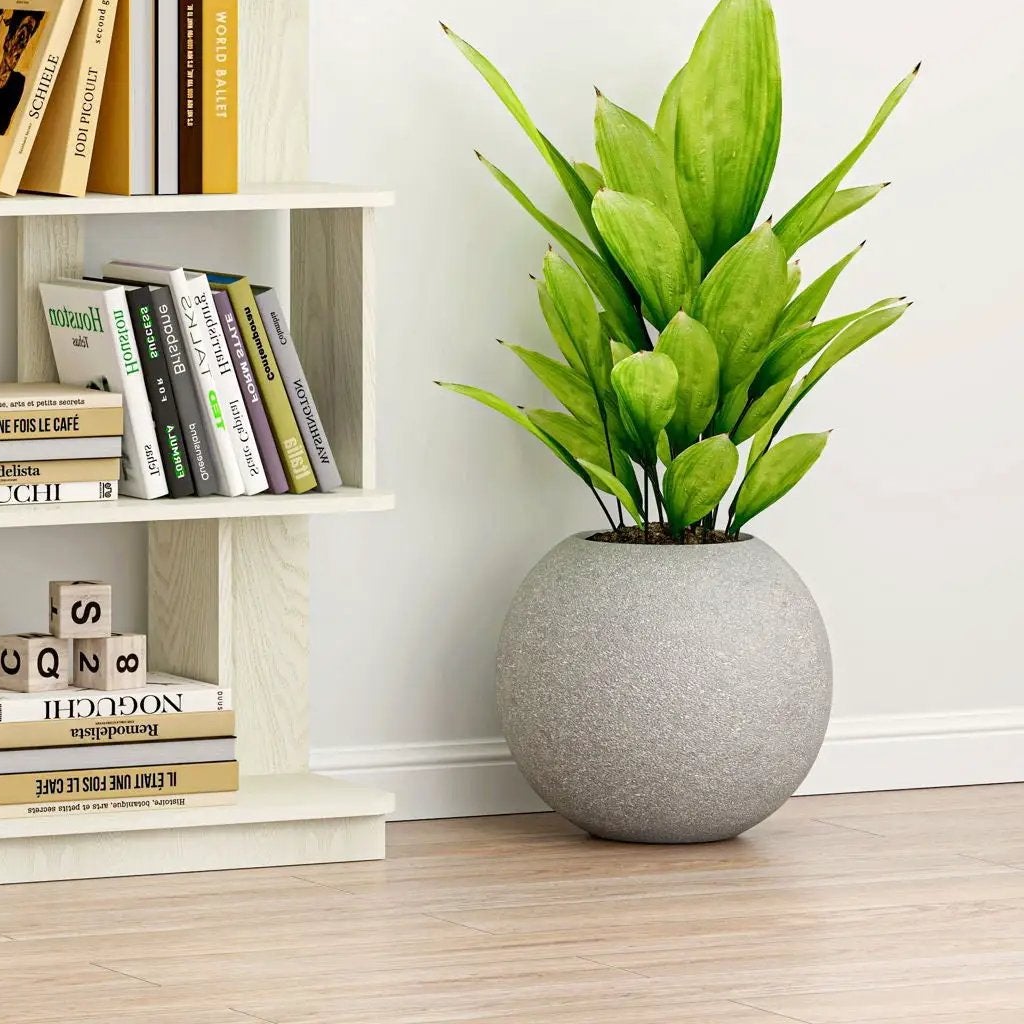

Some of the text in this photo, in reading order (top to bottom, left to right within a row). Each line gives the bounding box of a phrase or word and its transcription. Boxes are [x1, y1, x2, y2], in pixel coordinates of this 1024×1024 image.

[95, 8, 107, 44] second
[216, 11, 227, 118] WORLD BALLET
[29, 54, 60, 120] SCHIELE
[74, 67, 99, 158] JODI PICOULT
[10, 400, 26, 408] arts
[36, 399, 57, 408] petits
[58, 398, 85, 406] secrets
[14, 418, 36, 433] FOIS
[39, 418, 50, 432] LE
[54, 414, 80, 432] CAFÉ
[71, 600, 101, 625] S
[0, 648, 21, 675] C
[37, 647, 60, 680] Q
[80, 652, 100, 673] 2
[116, 653, 139, 674] 8
[43, 693, 184, 720] NOGUCHI
[70, 724, 159, 739] Remodelista
[36, 772, 177, 798] IL ÉTAIT UNE FOIS LE CAFÉ
[27, 806, 56, 815] secrets
[58, 803, 80, 813] petits
[82, 803, 90, 811] et
[92, 802, 109, 810] arts
